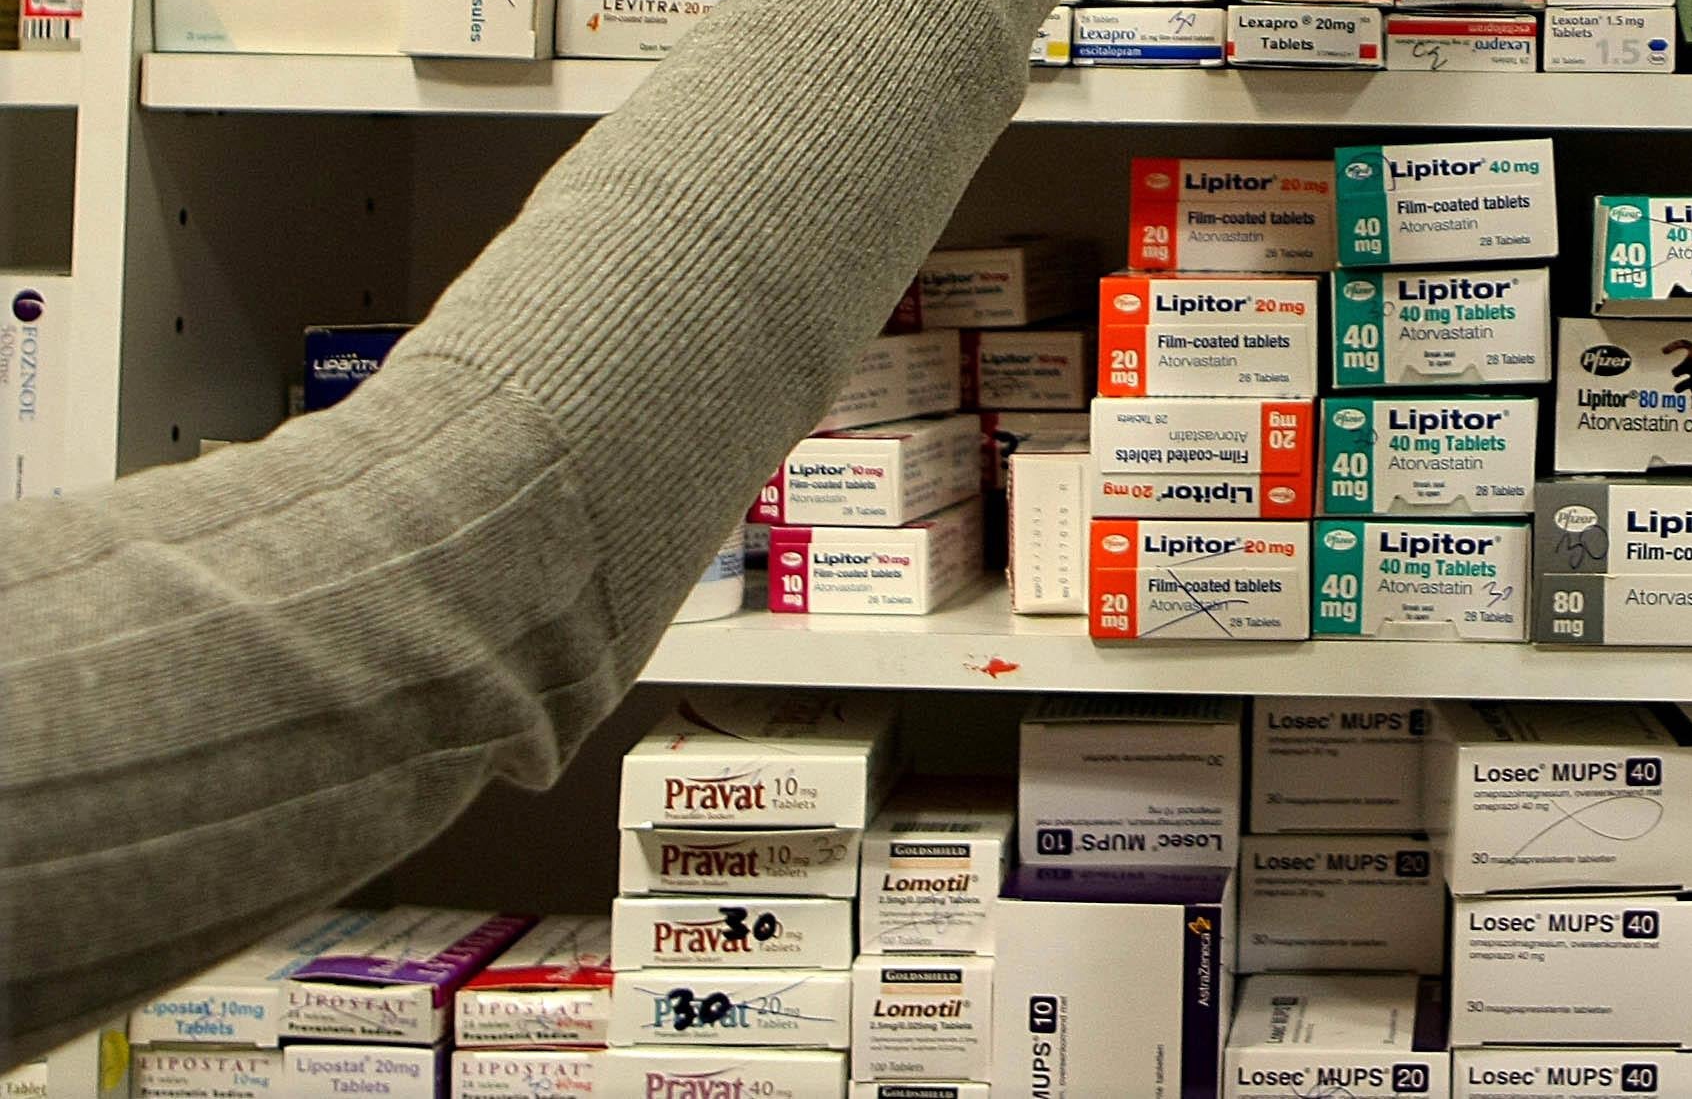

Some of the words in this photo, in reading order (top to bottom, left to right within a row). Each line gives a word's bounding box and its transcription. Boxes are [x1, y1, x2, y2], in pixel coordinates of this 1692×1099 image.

[1400, 279, 1511, 301] Lipitor
[1400, 306, 1420, 320] 40
[1424, 306, 1450, 324] mg
[1455, 304, 1516, 320] Tablets
[1158, 335, 1238, 349] Film-coated
[1242, 335, 1290, 349] tablets
[1582, 353, 1630, 370] Pfizer
[1578, 413, 1679, 432] Atorvastatin
[1104, 483, 1129, 498] mg
[1132, 483, 1154, 498] 20
[1162, 485, 1253, 504] Lipitor
[814, 552, 872, 566] Lipitor
[1322, 574, 1357, 599] 40
[1473, 763, 1539, 782] Losec
[1551, 763, 1617, 782] MUPS
[1630, 761, 1657, 782] 40
[665, 778, 766, 810] Pravat
[774, 777, 798, 796] 10
[882, 873, 971, 893] Lomotil
[720, 907, 776, 942] 30
[1198, 932, 1210, 1007] AstraZeneca
[296, 1058, 367, 1075] Lipostat
[372, 1060, 420, 1077] 20mg
